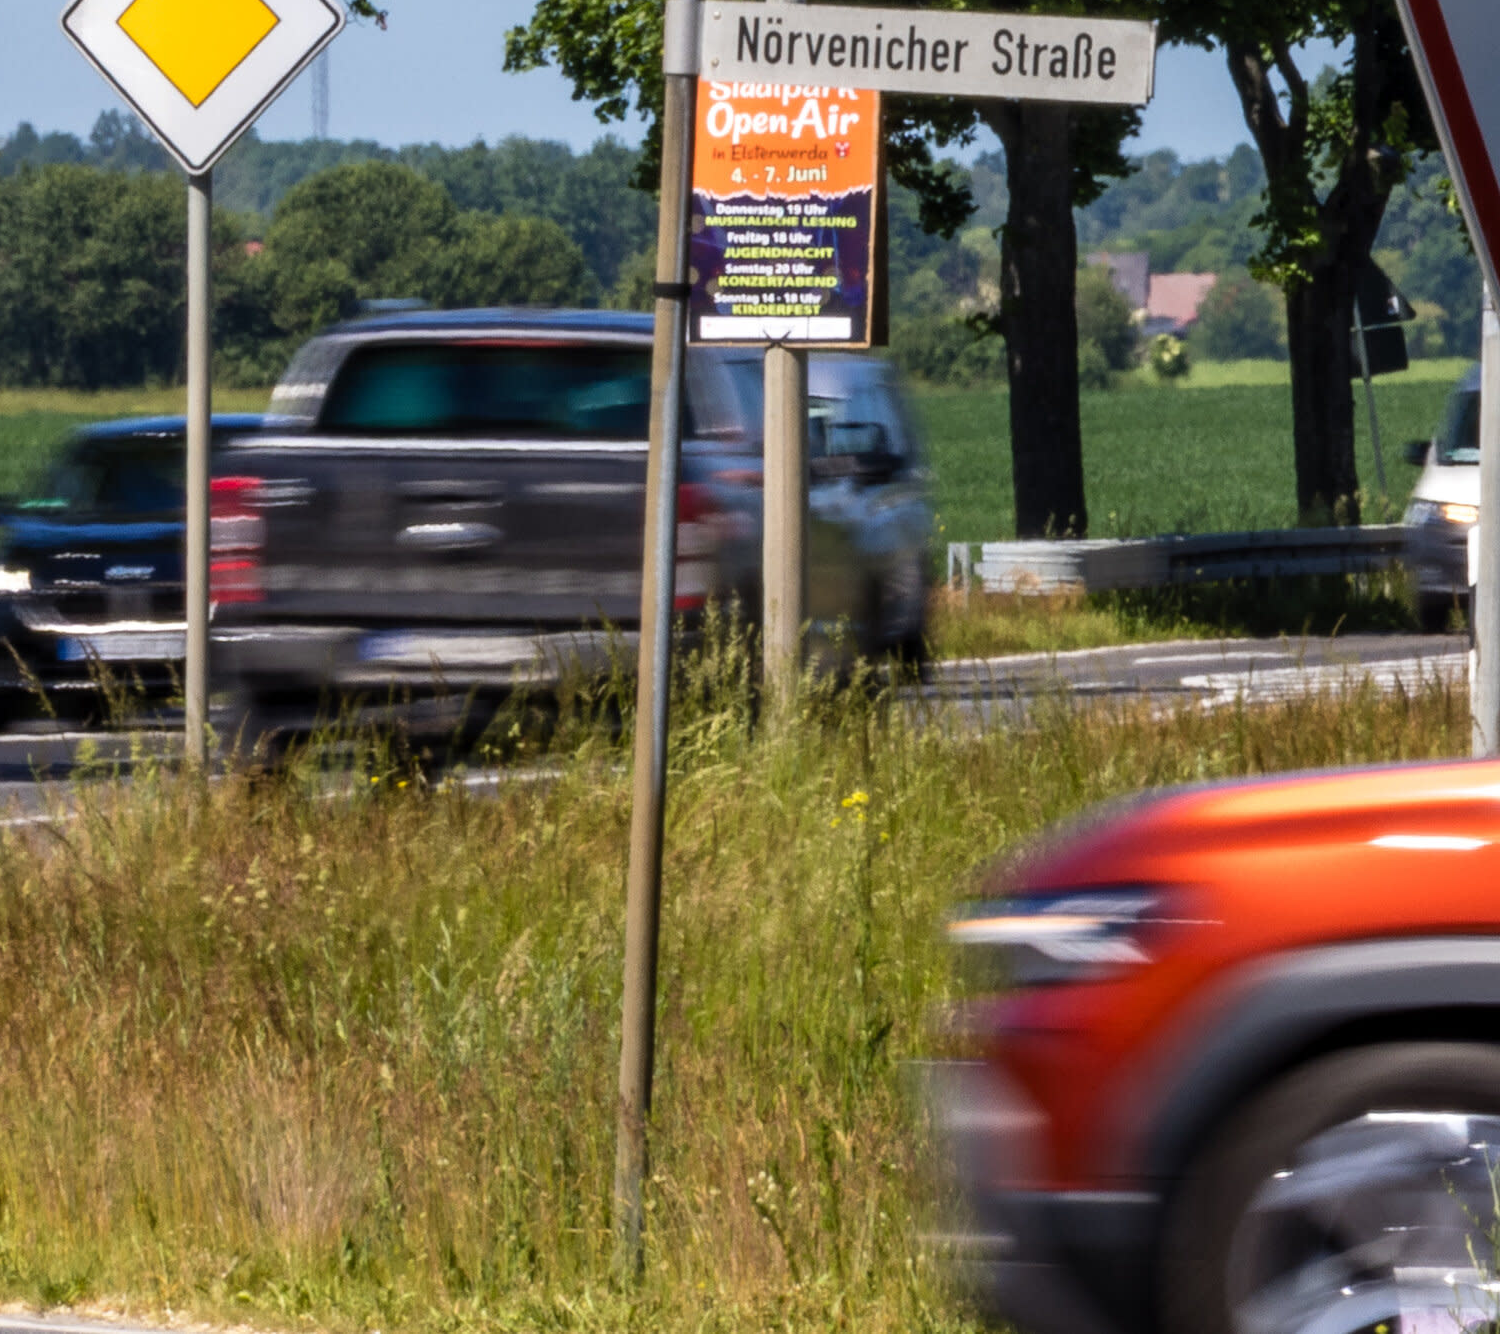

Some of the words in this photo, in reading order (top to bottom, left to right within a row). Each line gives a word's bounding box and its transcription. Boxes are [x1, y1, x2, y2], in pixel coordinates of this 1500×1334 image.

[736, 16, 969, 74] Nörvenicher
[991, 28, 1117, 80] Straße
[731, 167, 747, 183] 4.
[764, 166, 781, 183] 7.
[786, 164, 828, 182] Juni
